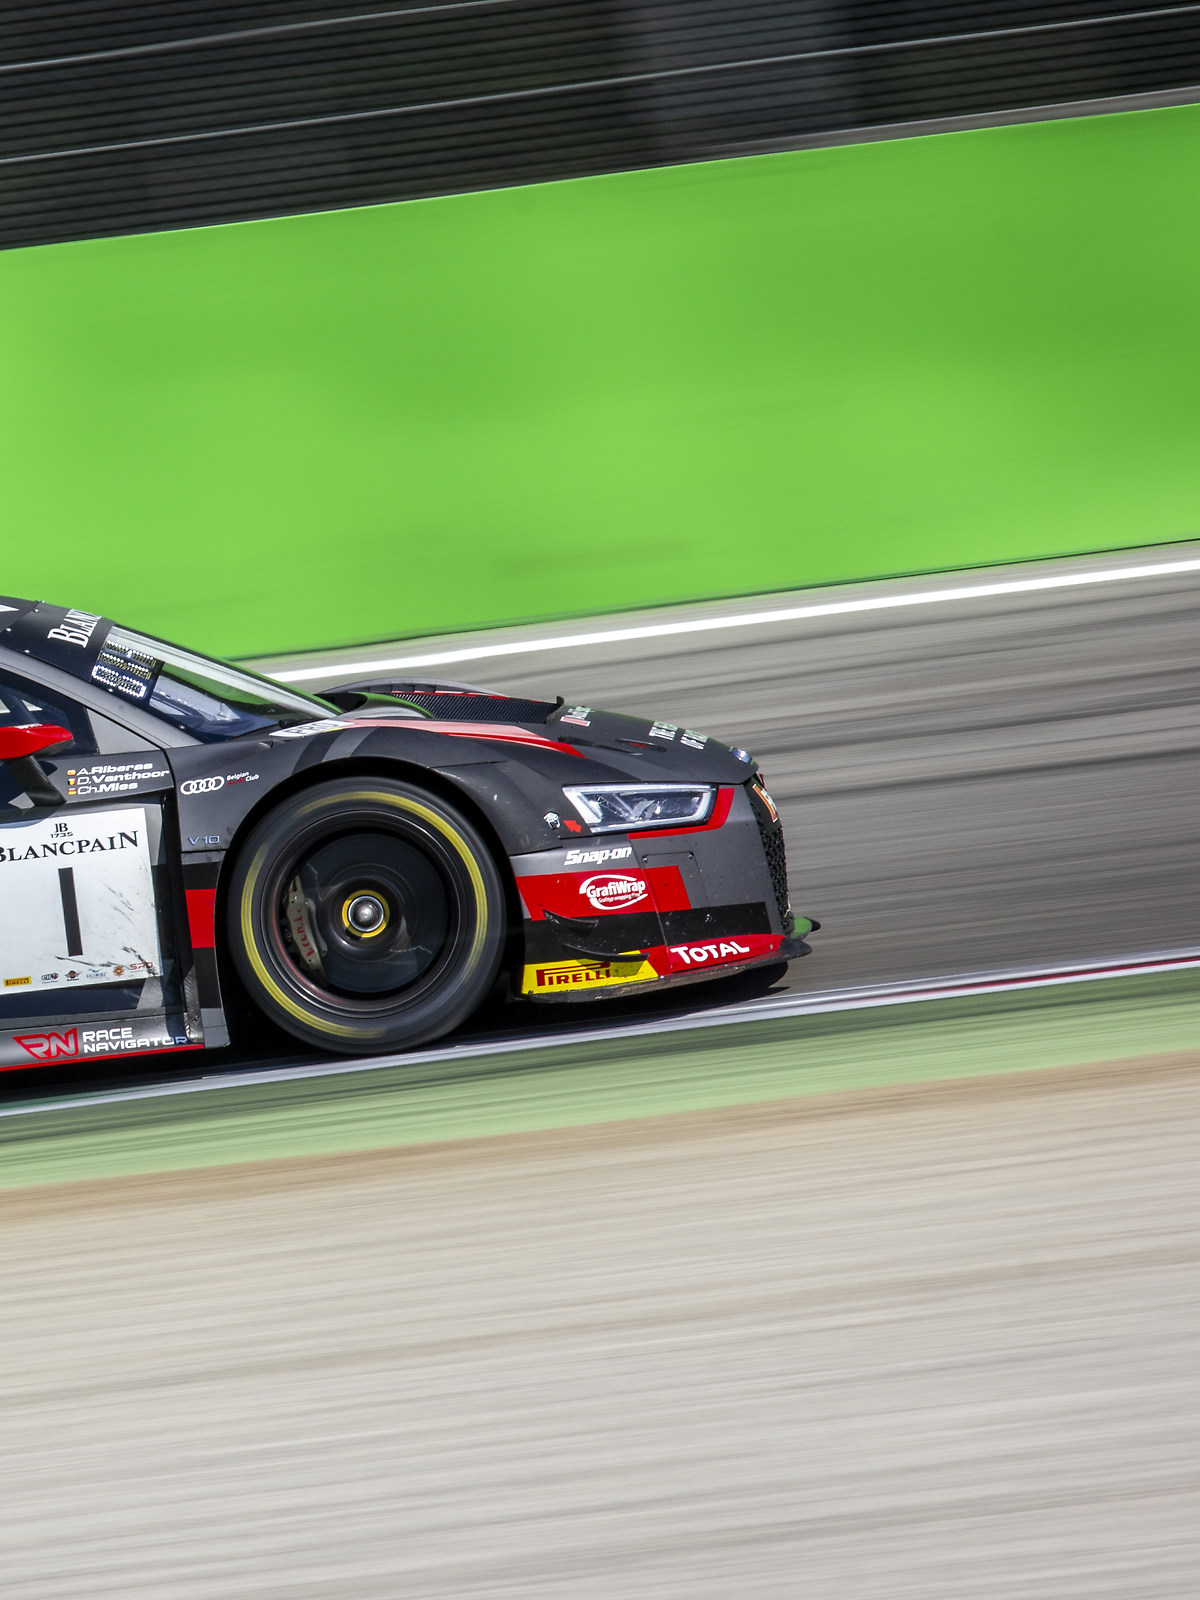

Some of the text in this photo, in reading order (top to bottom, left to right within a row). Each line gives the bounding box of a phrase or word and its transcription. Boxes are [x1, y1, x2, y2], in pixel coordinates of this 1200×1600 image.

[245, 773, 260, 782] Club
[50, 831, 74, 839] 1735
[564, 846, 633, 866] Snap-on
[586, 880, 646, 899] GrafiWrap
[58, 867, 83, 957] 1
[670, 941, 750, 964] TOTAL
[536, 961, 611, 986] PIRELLI
[82, 1027, 133, 1043] RACE
[83, 1035, 188, 1054] NAVIGATOR
